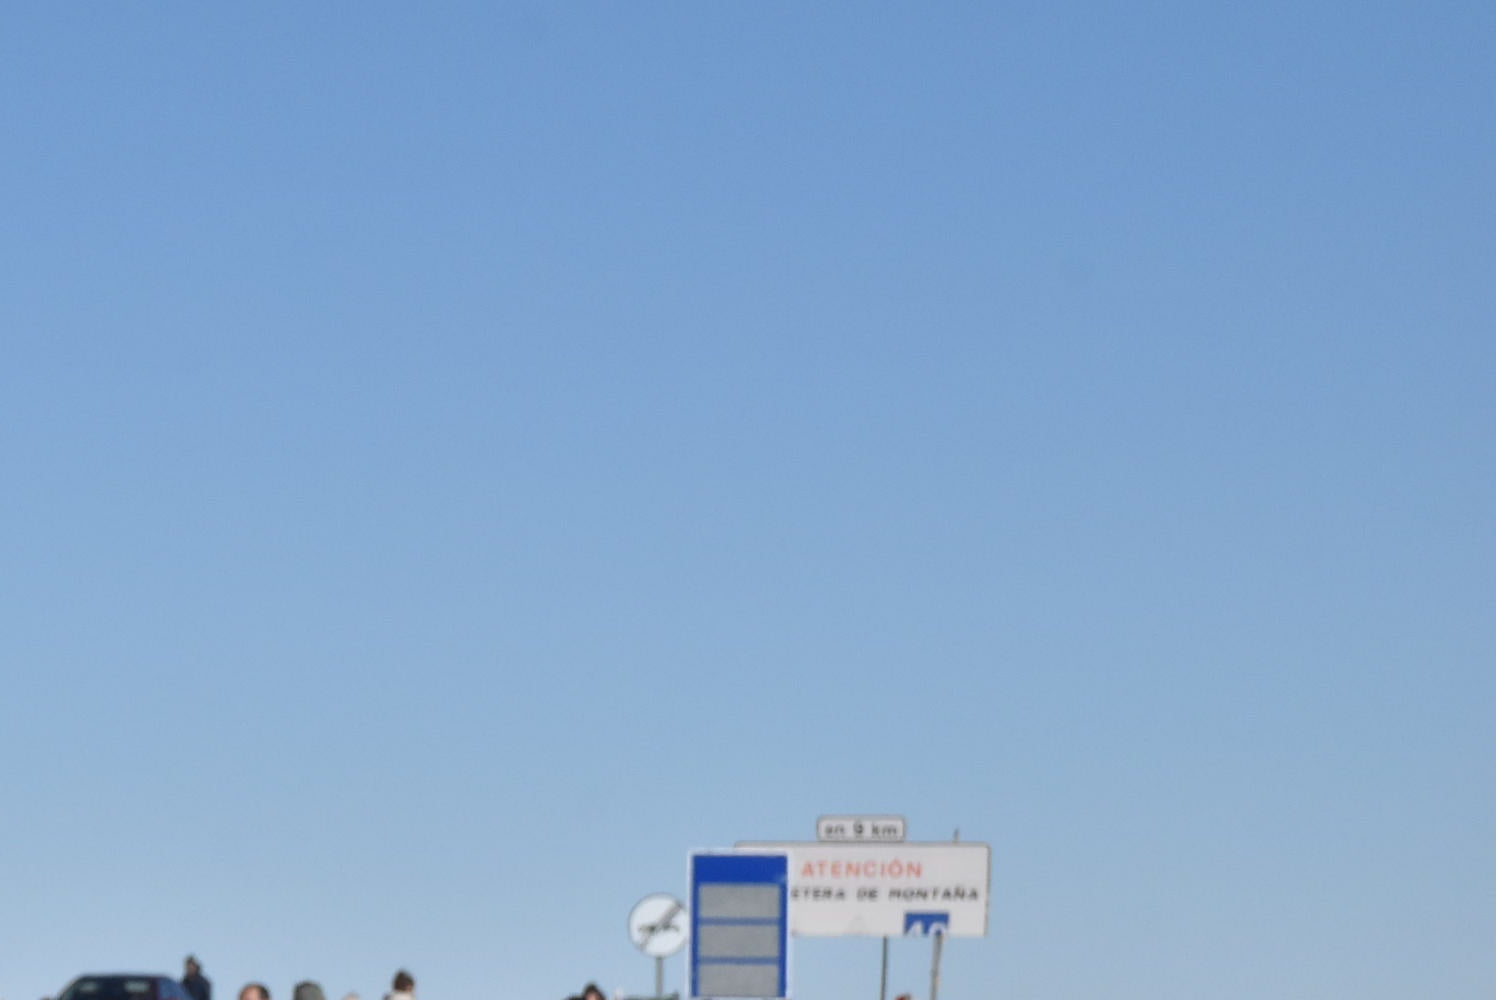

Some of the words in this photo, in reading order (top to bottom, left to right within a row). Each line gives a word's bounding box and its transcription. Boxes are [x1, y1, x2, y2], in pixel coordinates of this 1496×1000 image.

[801, 859, 922, 878] ATENCIÓN
[856, 886, 879, 901] DE
[888, 883, 979, 901] MONTAÑA
